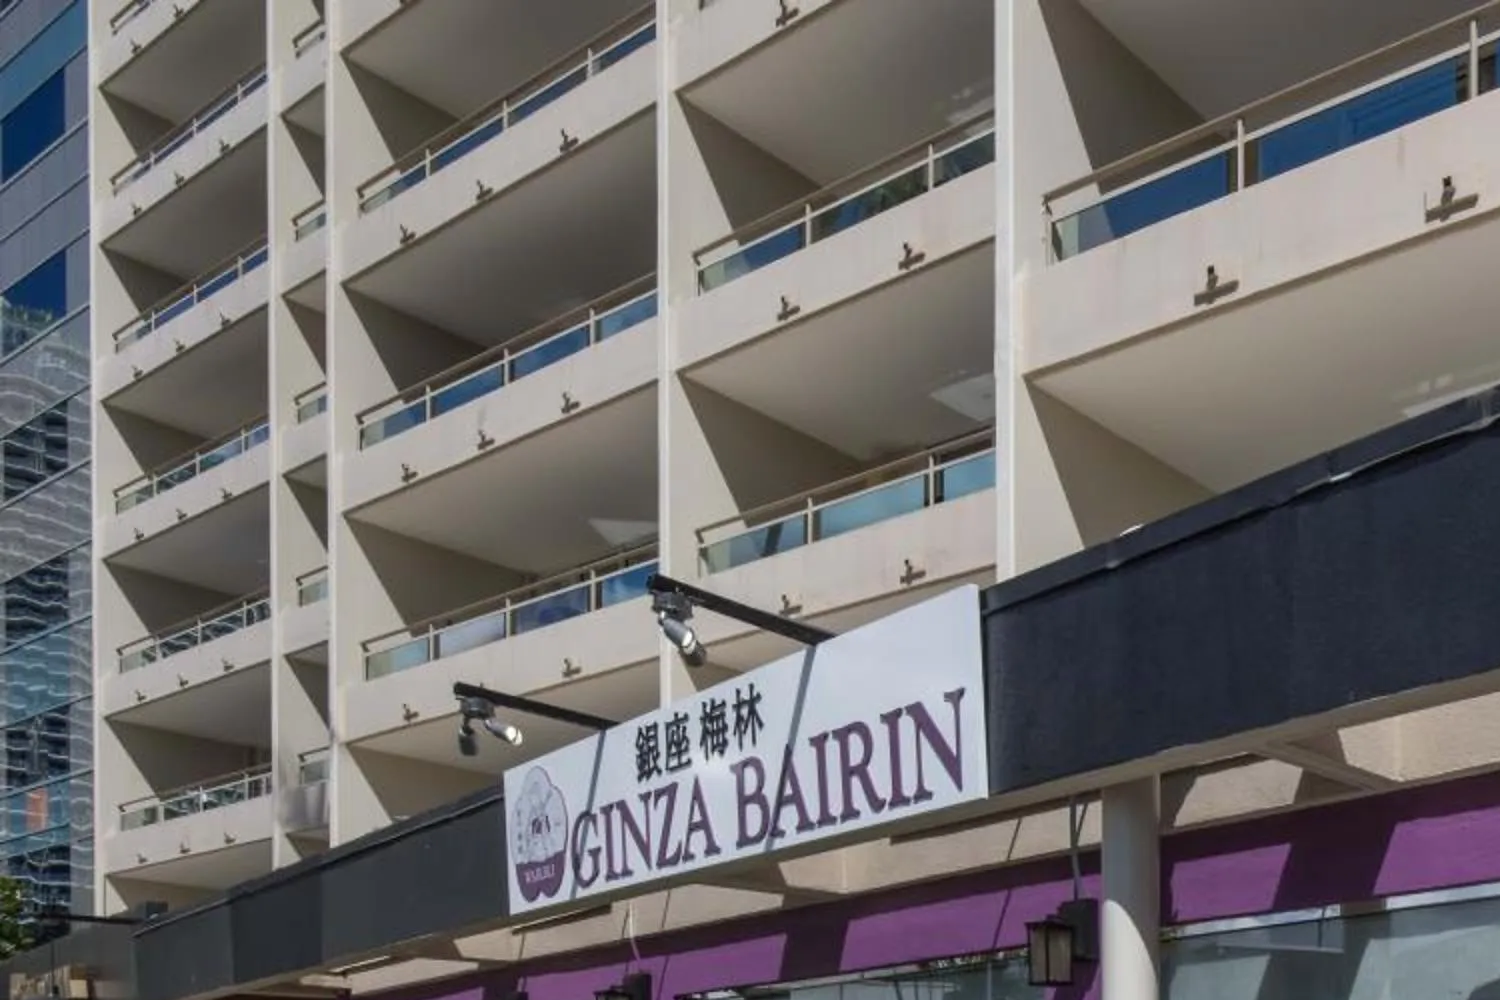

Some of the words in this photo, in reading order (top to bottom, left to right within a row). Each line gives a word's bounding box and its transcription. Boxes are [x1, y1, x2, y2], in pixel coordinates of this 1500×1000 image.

[570, 774, 724, 889] GINZA
[729, 686, 967, 850] BAIRIN
[635, 682, 764, 783] 銀座梅林
